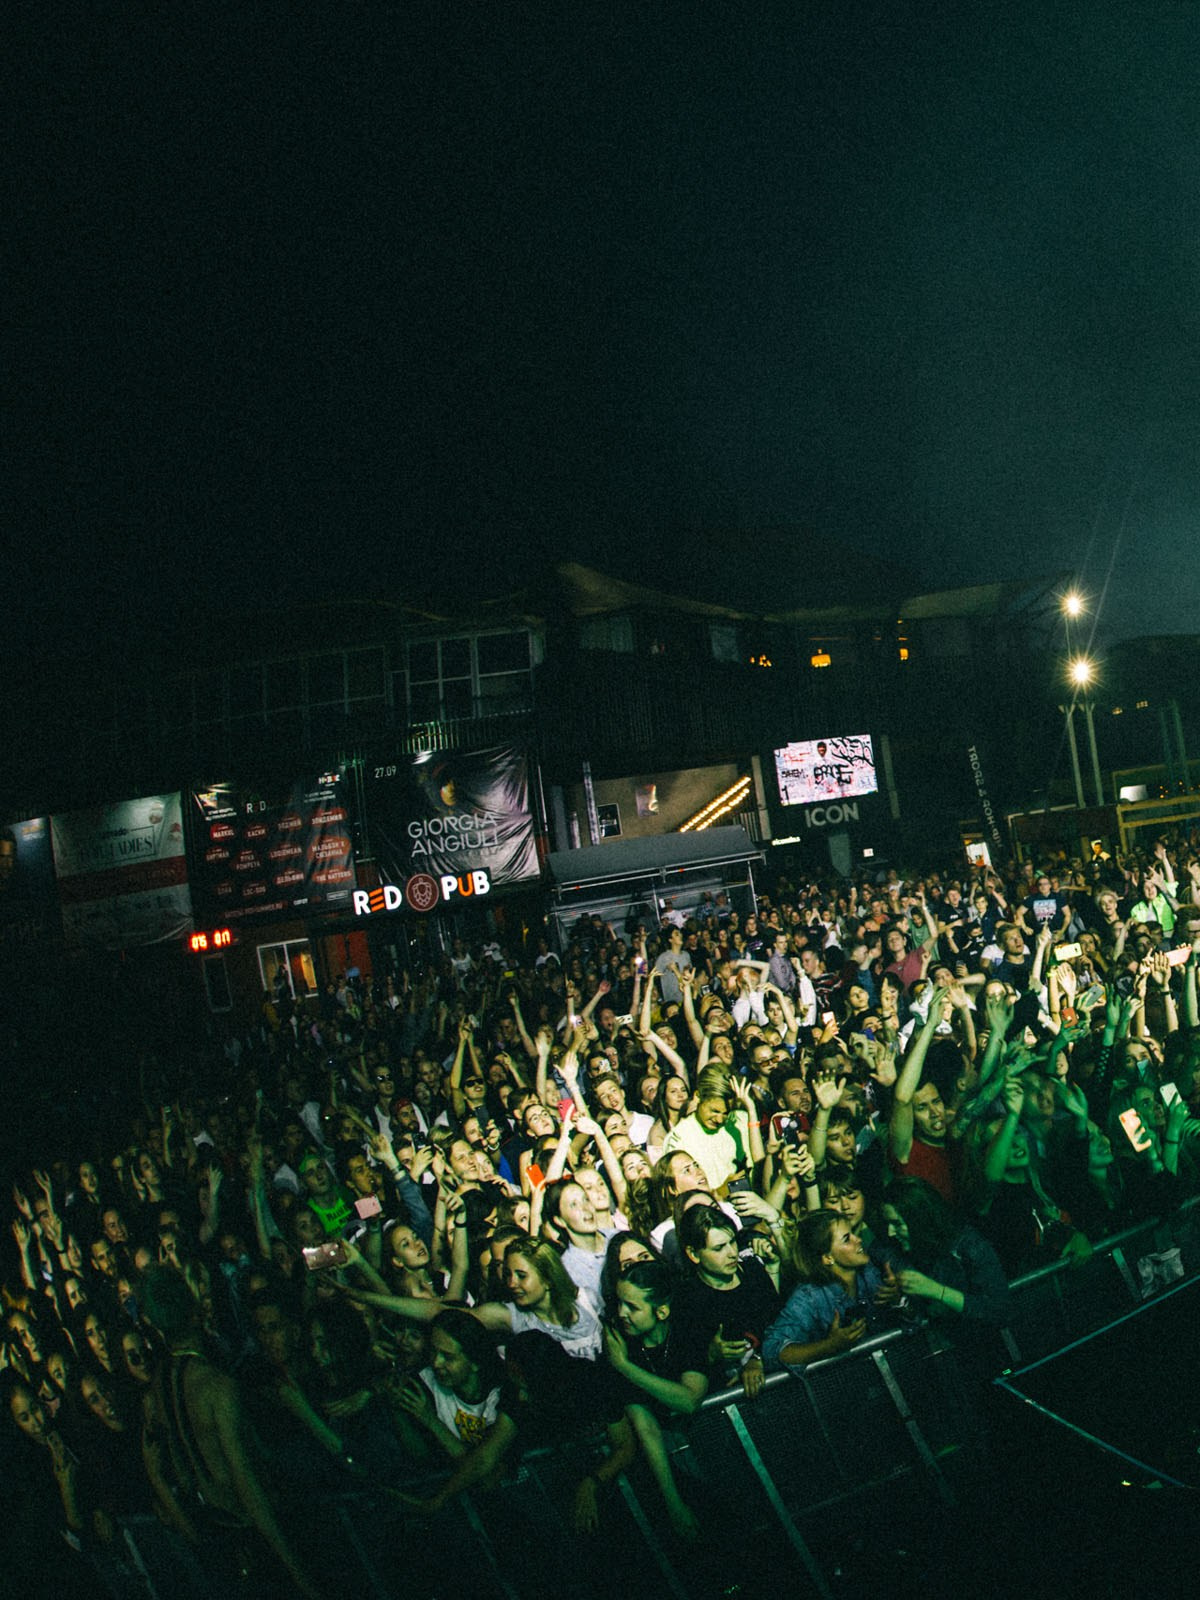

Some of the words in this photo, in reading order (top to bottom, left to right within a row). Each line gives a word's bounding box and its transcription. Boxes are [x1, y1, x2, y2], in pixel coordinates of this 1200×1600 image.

[374, 765, 397, 779] 27.09
[246, 800, 266, 814] RD
[804, 802, 859, 828] ICON
[407, 813, 498, 839] GIORGIA
[411, 831, 499, 858] ANGIULI
[352, 885, 402, 916] RED
[440, 870, 490, 901] PUB
